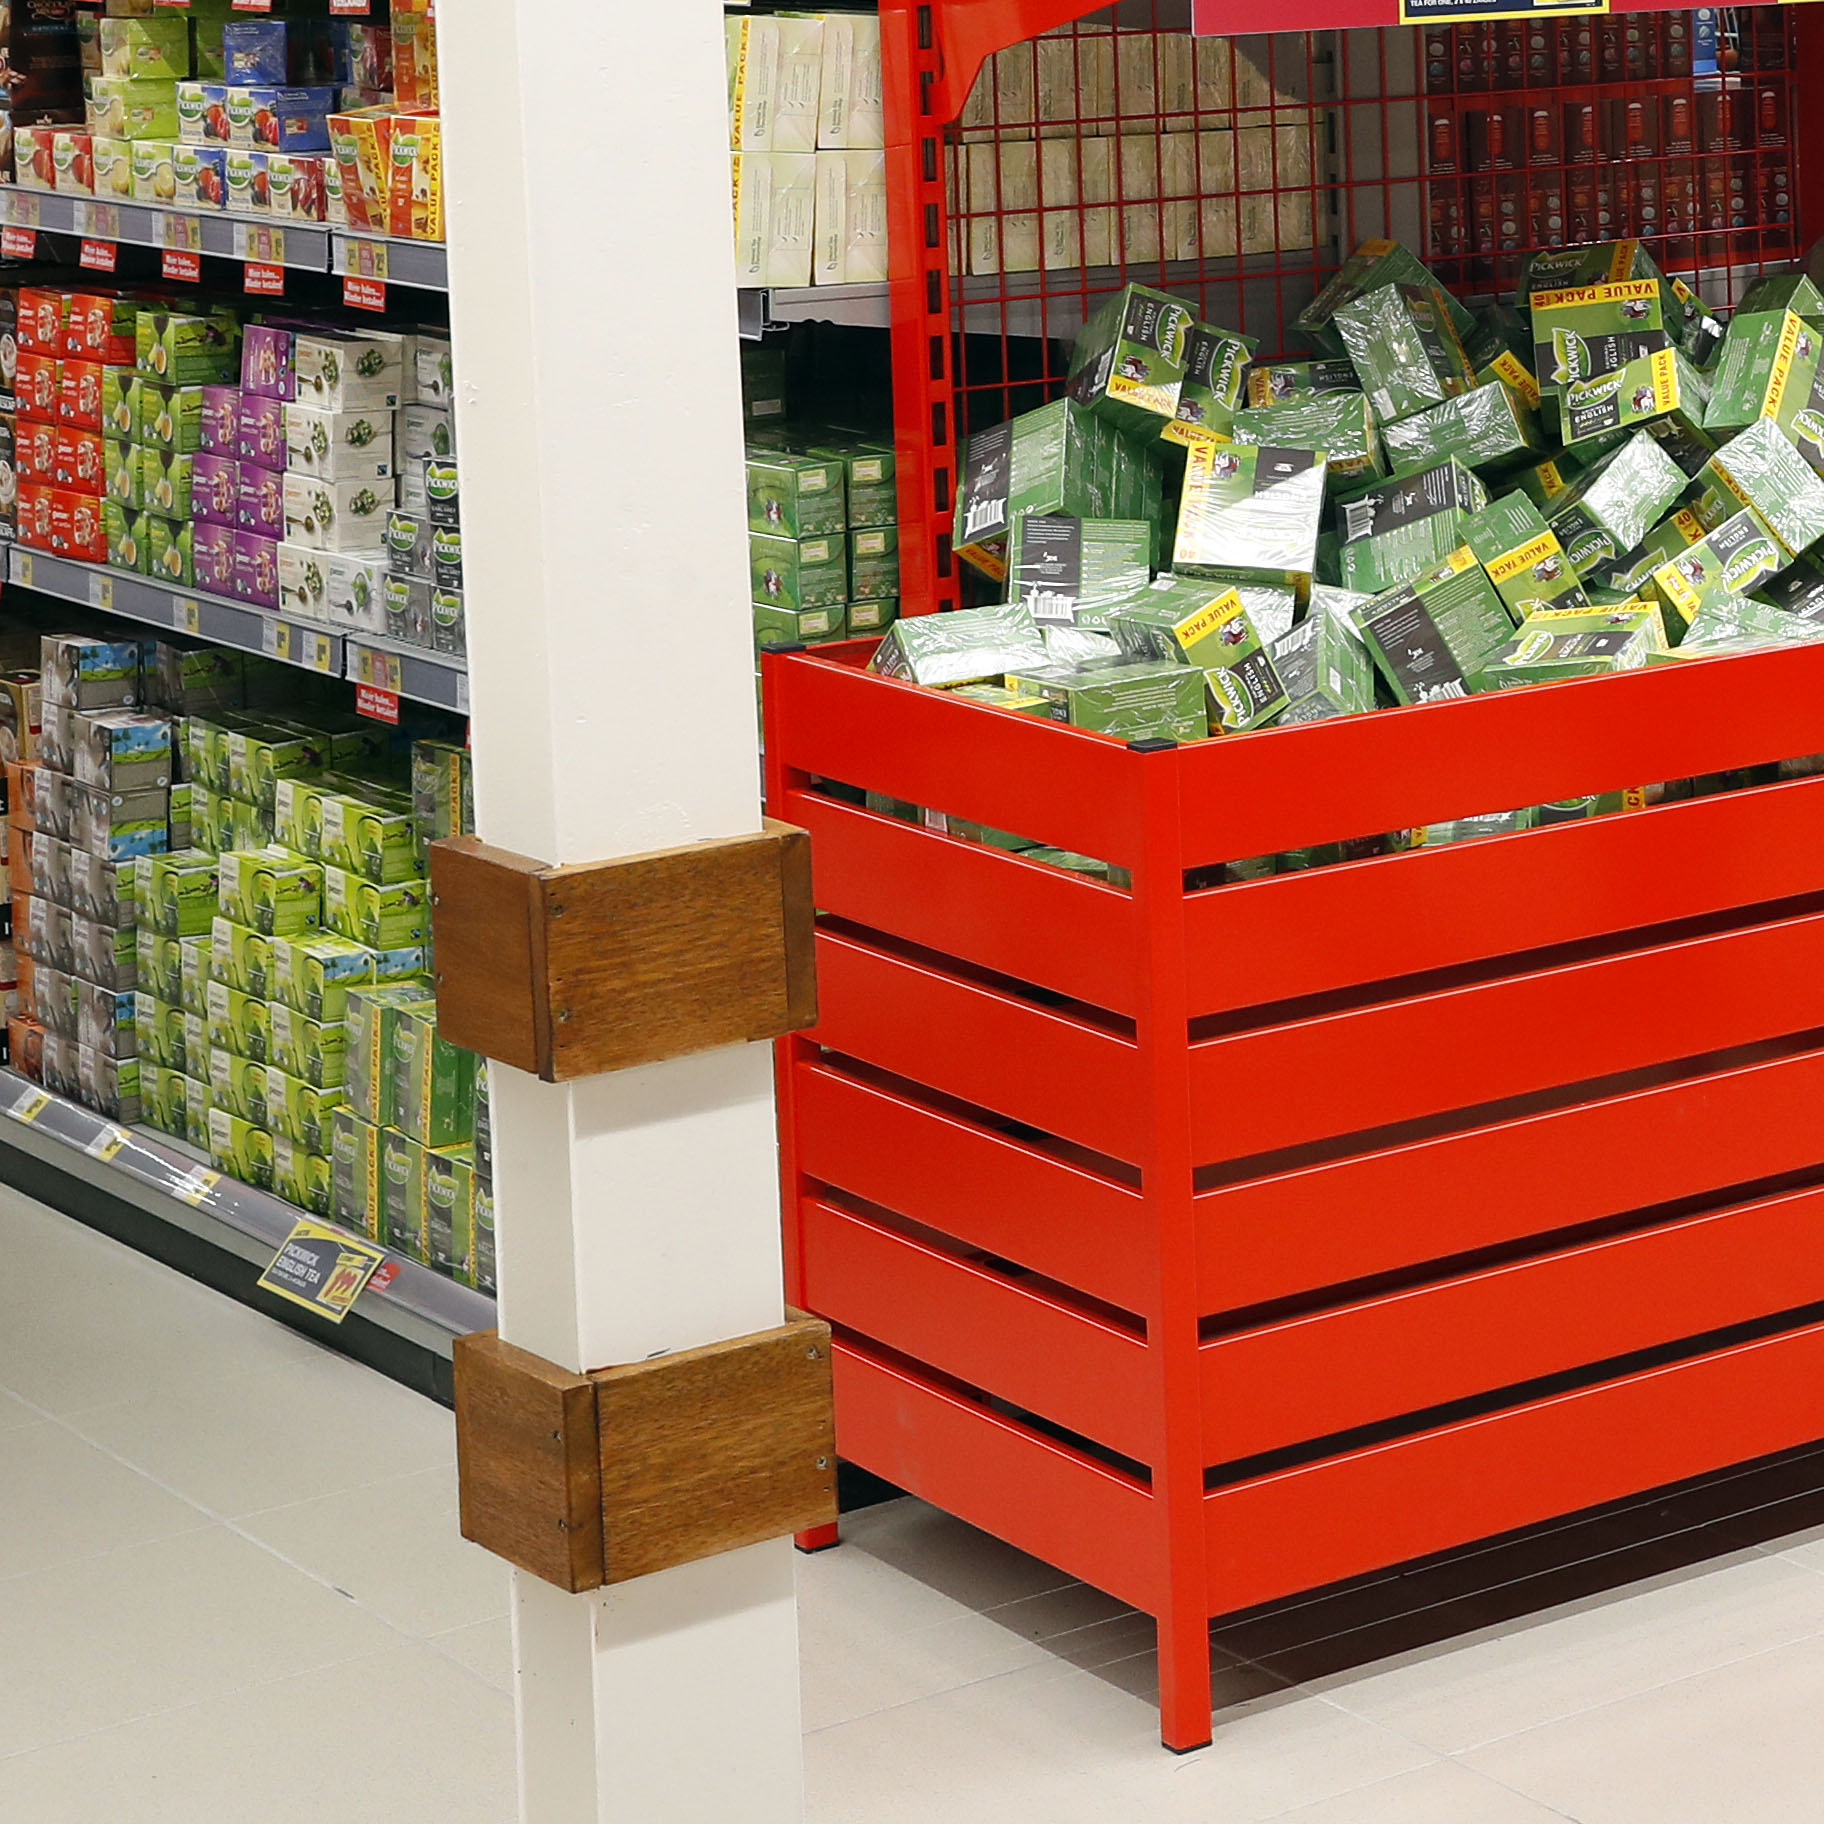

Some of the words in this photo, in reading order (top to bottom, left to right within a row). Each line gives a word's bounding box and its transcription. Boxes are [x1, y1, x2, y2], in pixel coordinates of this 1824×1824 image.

[736, 38, 747, 85] PACK
[733, 88, 745, 150] VALUE
[429, 191, 437, 236] VALUE
[1530, 257, 1583, 274] PICKWICK
[1554, 287, 1598, 303] PACK
[1603, 282, 1655, 299] VALUE
[1161, 303, 1183, 360] PICKWICK
[1778, 316, 1799, 368] VALUE
[1214, 337, 1241, 404] PICKWICK
[1659, 353, 1674, 377] PACK
[1567, 380, 1623, 408] PICKWICK
[1661, 379, 1674, 407] VALUE
[1768, 369, 1787, 413] PACK
[1574, 404, 1615, 424] ENGLISH
[1209, 599, 1237, 622] VALUE
[1182, 619, 1208, 639] PACK
[1216, 666, 1251, 727] PICKWICK
[305, 1267, 321, 1284] TEA
